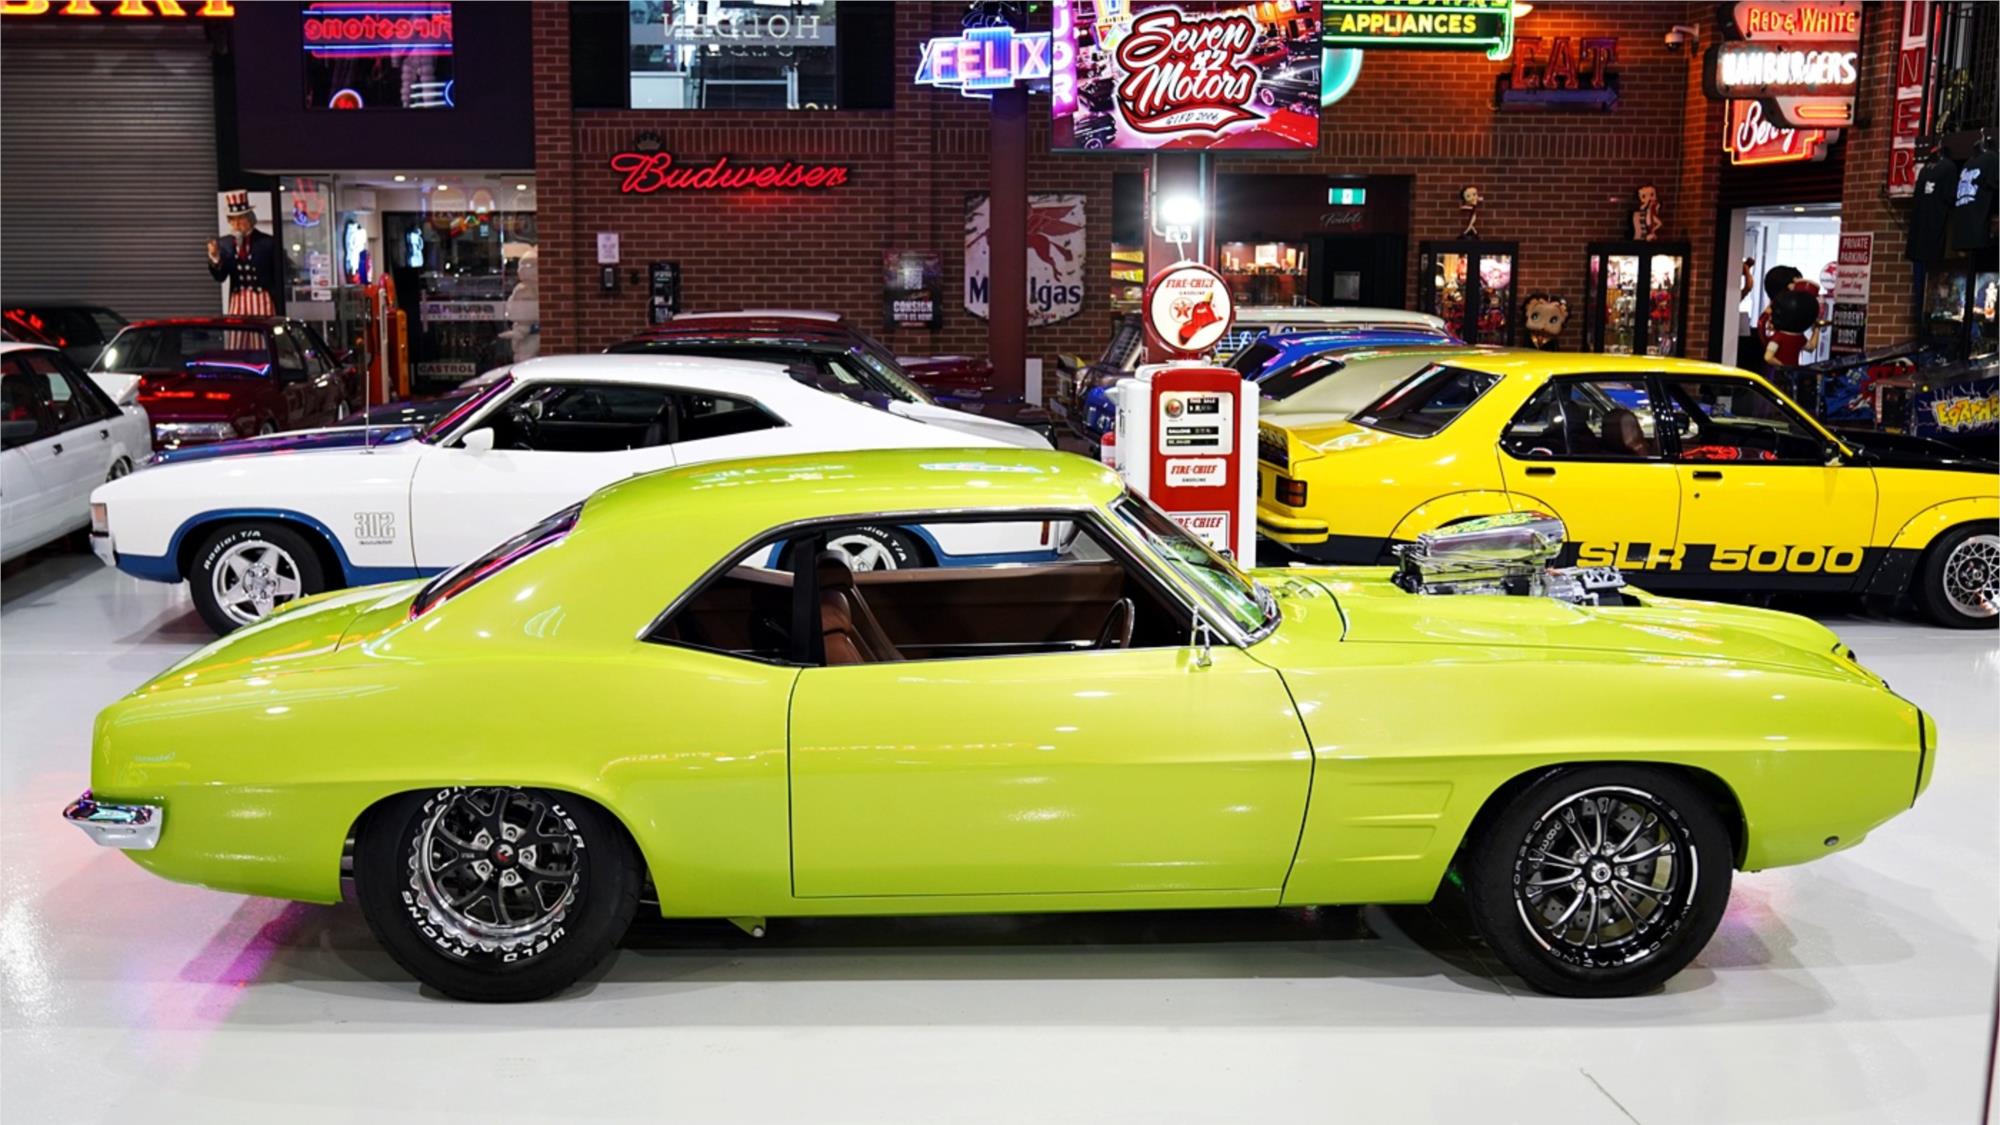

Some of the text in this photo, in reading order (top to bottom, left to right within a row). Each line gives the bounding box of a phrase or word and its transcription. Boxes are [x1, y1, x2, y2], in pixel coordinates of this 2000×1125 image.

[1340, 13, 1476, 33] APPLIANCES
[1748, 8, 1856, 34] RED & WHITE
[1053, 0, 1074, 102] JOR
[1123, 16, 1250, 68] Seven
[933, 38, 1048, 82] FELIX
[1190, 50, 1227, 71] 82
[1511, 37, 1617, 89] EAT
[1722, 51, 1857, 86] HAMBURGERS
[1126, 63, 1250, 112] Motors
[611, 152, 848, 192] Budweiser
[1840, 251, 1868, 264] PARKING
[1842, 237, 1869, 249] PRIVATE
[893, 300, 933, 312] CONSIGN
[969, 276, 1081, 311] Mlgas
[419, 364, 473, 373] CASTROL
[1171, 465, 1218, 474] FIRE-CHIEF
[240, 530, 261, 538] T/A
[354, 512, 396, 539] 302
[1577, 542, 1864, 573] SLR 5000
[552, 804, 585, 848] USA
[401, 890, 469, 957] RACING
[503, 927, 565, 962] WELD
